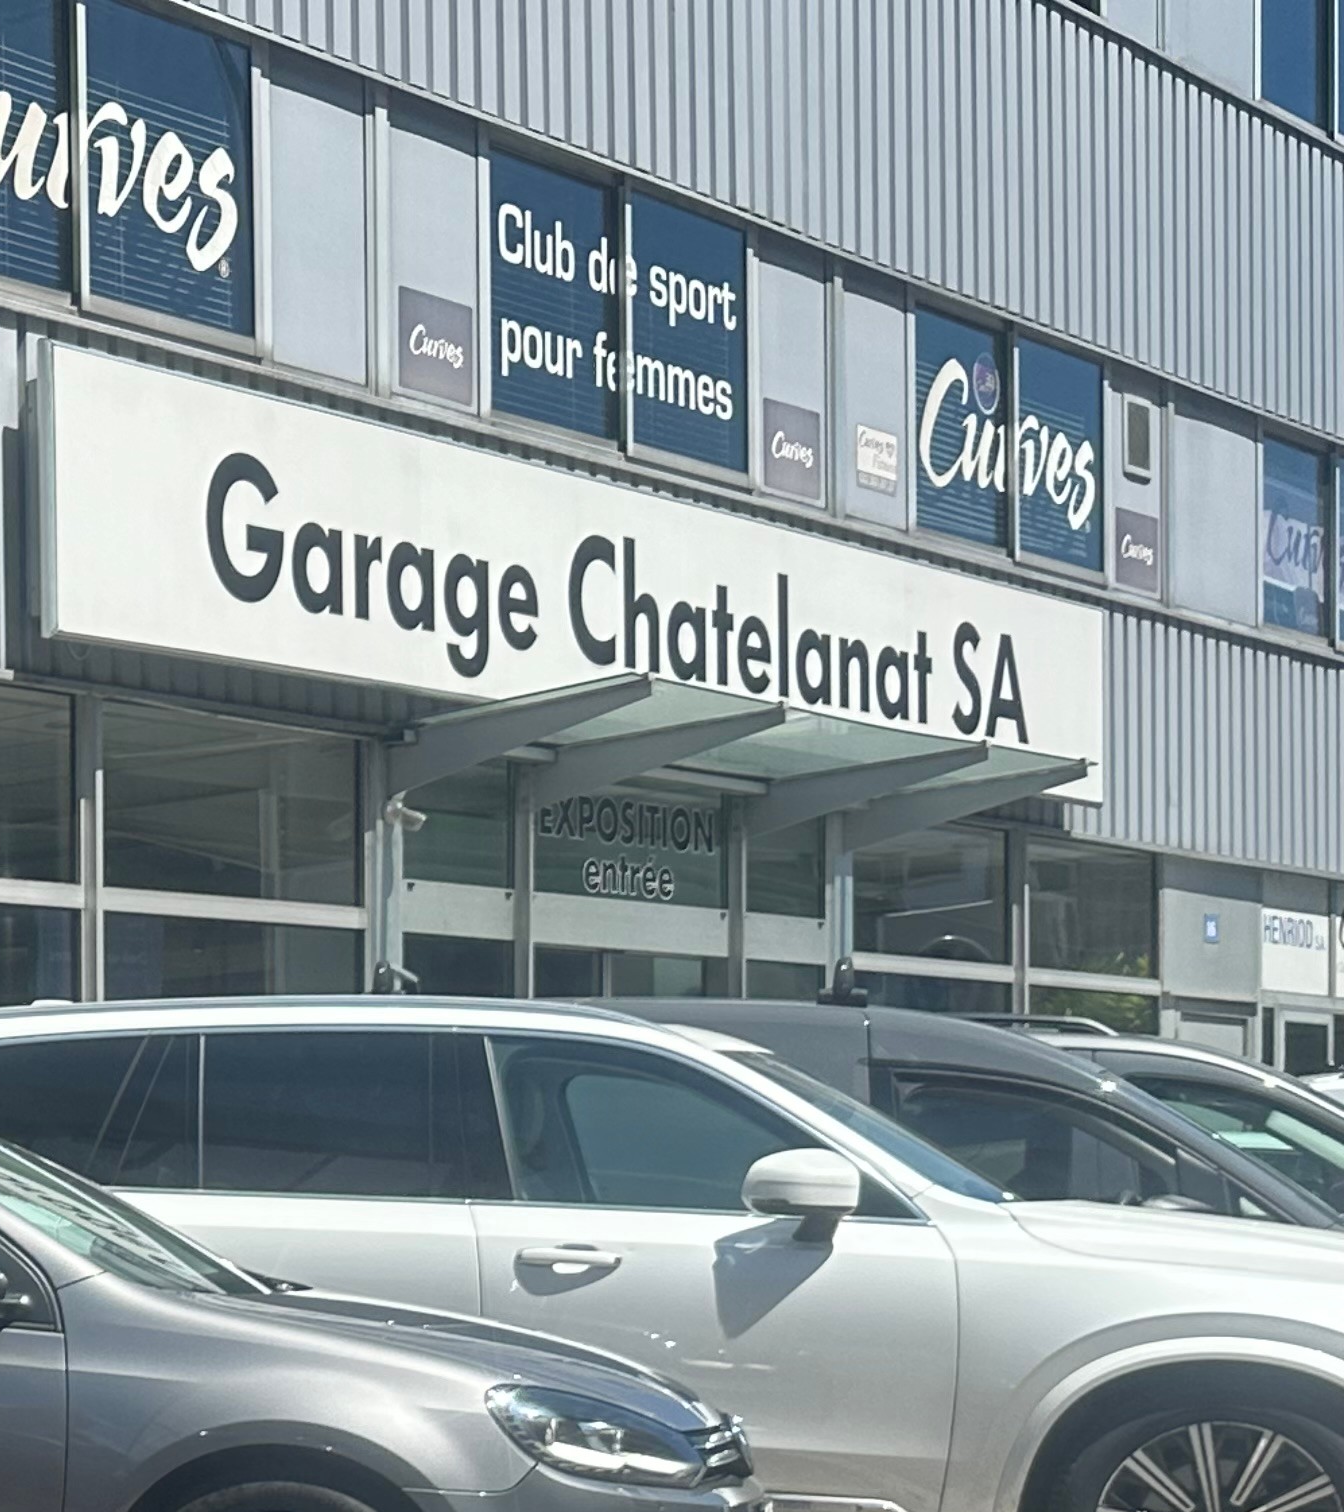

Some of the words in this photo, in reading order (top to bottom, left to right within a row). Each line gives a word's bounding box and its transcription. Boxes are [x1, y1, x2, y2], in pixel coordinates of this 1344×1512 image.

[498, 203, 575, 281] Club
[588, 237, 638, 297] de
[650, 264, 737, 332] sport
[409, 323, 464, 369] Curves
[500, 317, 583, 380] pour
[594, 331, 733, 421] femmes
[771, 431, 814, 469] Curves
[918, 357, 1096, 531] Curves
[207, 452, 539, 679] Garage
[568, 535, 933, 724] Chatelanat
[952, 621, 1029, 745] SA
[539, 797, 717, 856] EXPOSITION
[583, 854, 675, 901] entrée
